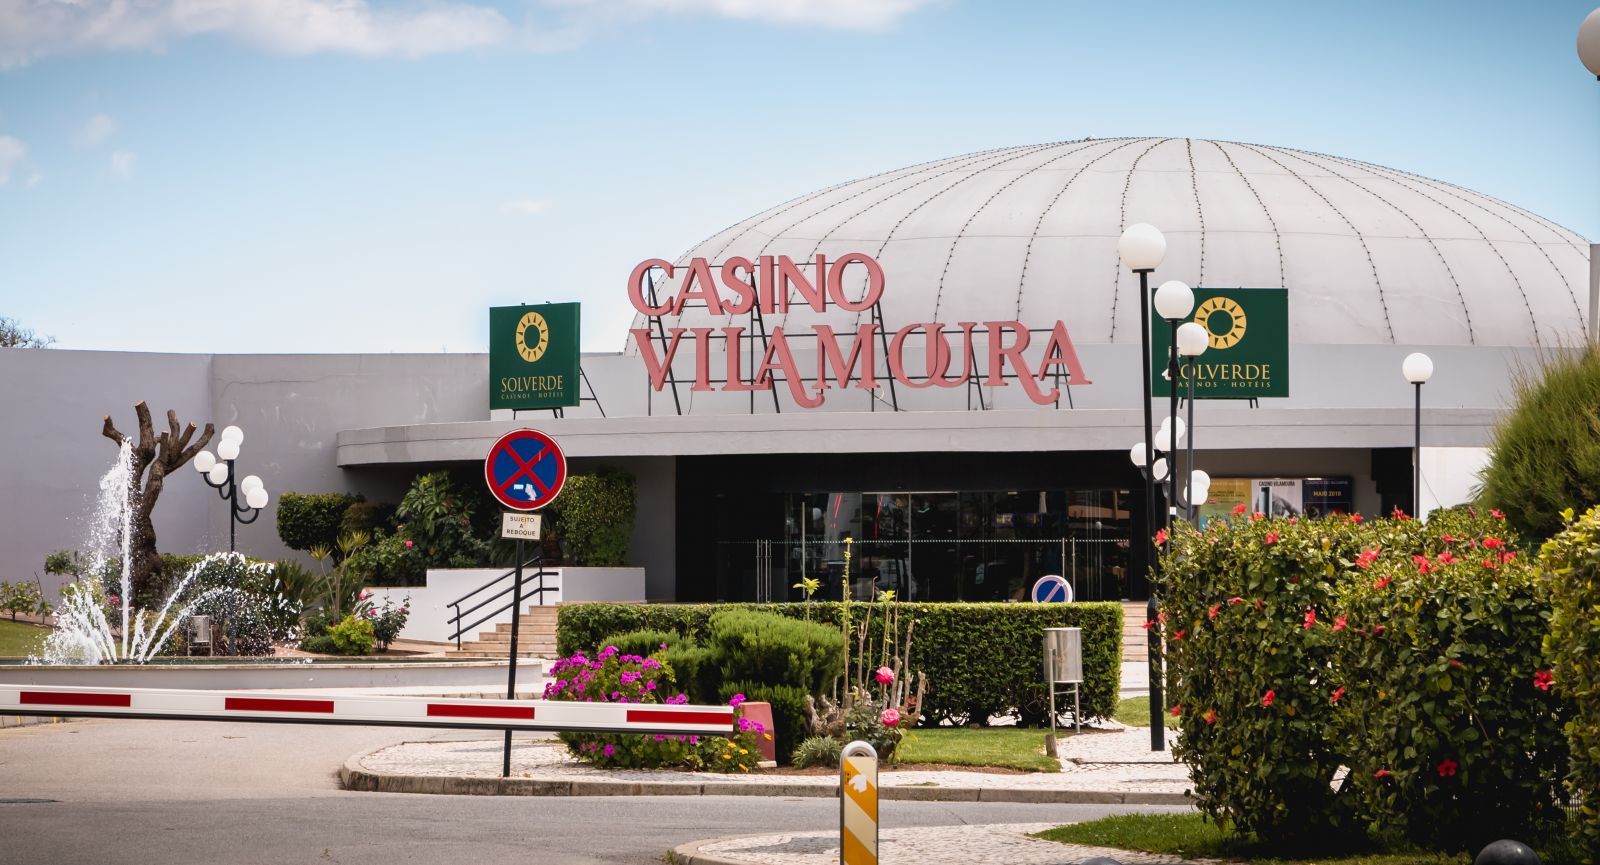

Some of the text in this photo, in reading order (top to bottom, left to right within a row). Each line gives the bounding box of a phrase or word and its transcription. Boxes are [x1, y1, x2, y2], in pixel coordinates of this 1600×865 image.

[627, 252, 886, 317] CASINO
[629, 319, 1093, 409] VILAMOURA
[1174, 363, 1271, 380] OLVERDE
[501, 375, 564, 393] SOLVERDE
[1231, 380, 1271, 388] HOTÉIS
